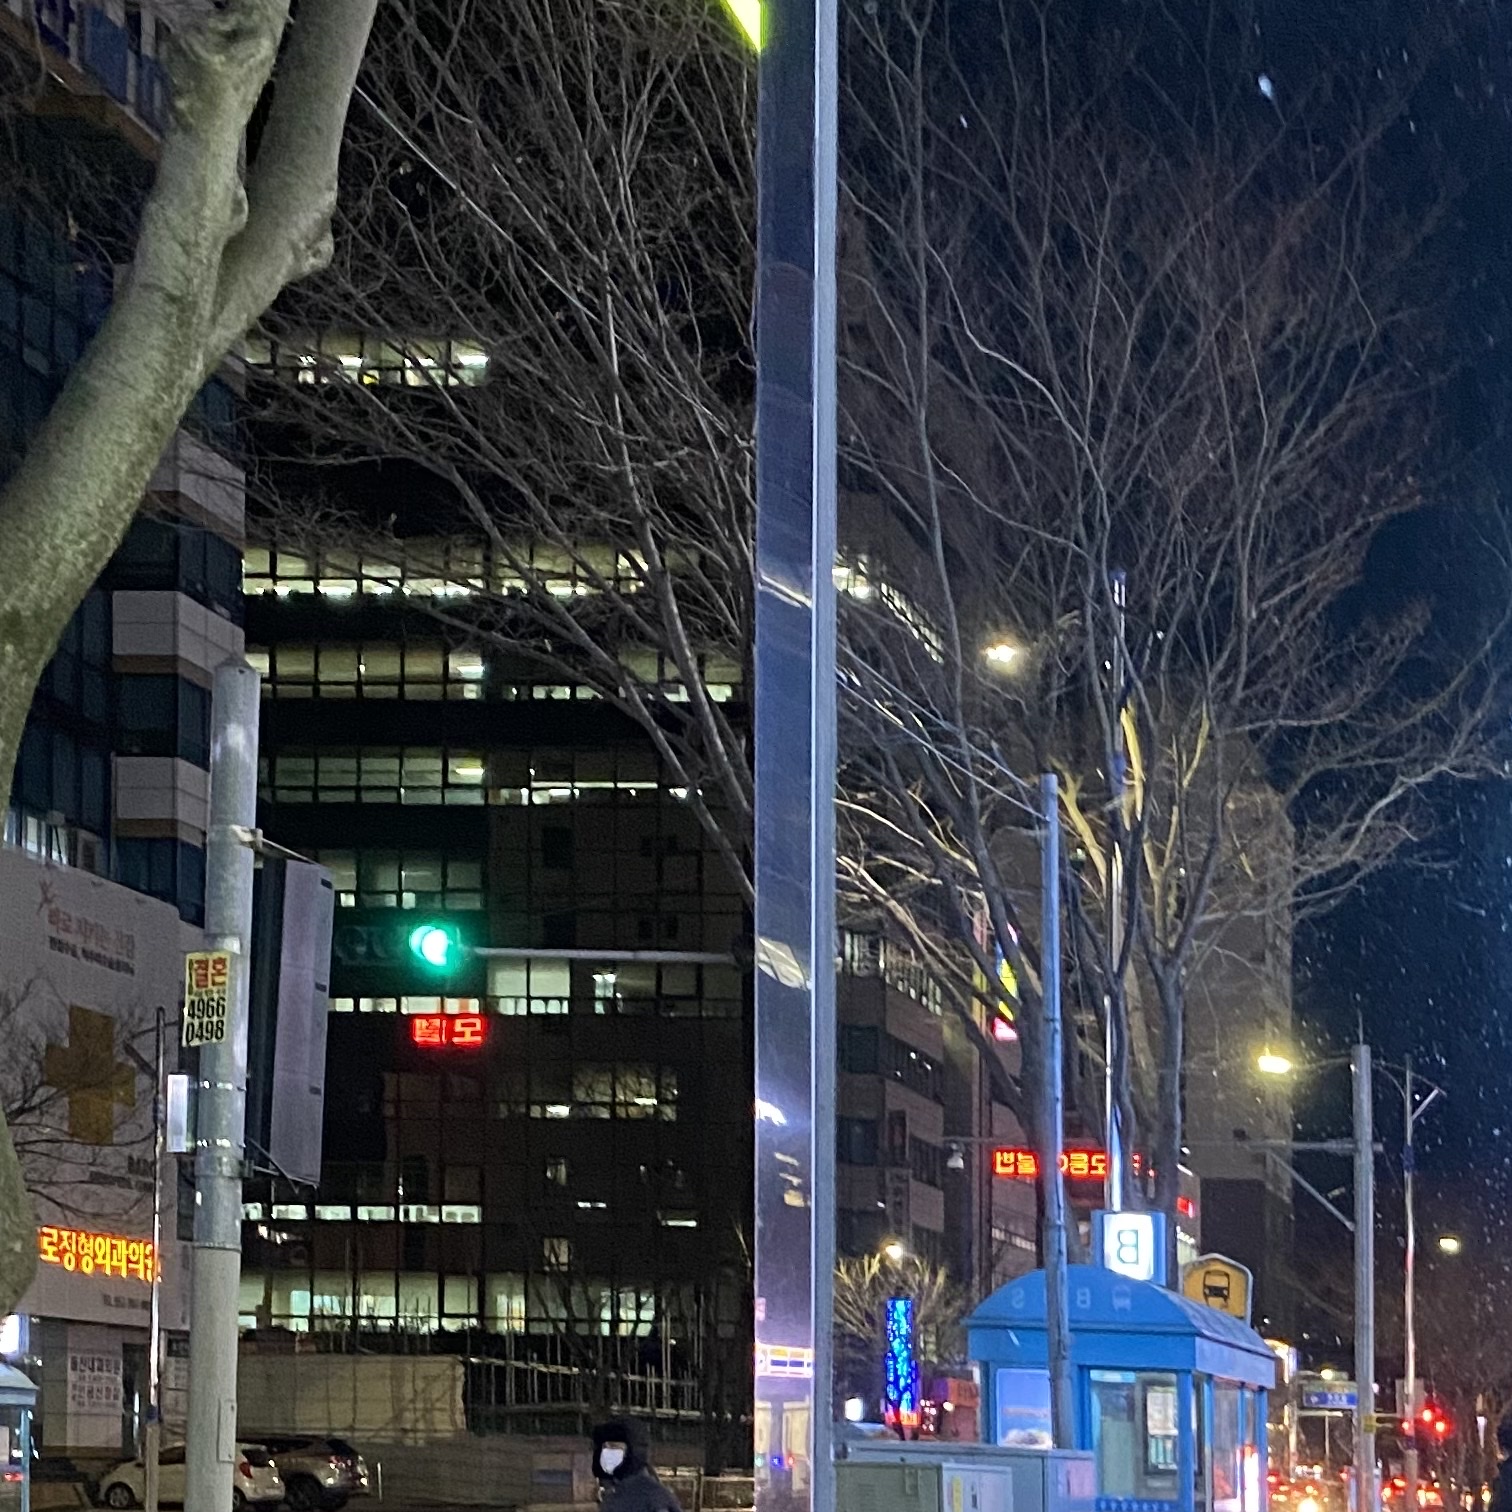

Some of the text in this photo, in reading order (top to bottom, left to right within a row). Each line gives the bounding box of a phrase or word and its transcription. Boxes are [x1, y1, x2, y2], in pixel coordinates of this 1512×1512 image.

[194, 957, 228, 989] 결혼
[187, 996, 226, 1019] 4966
[185, 1019, 225, 1045] 0498
